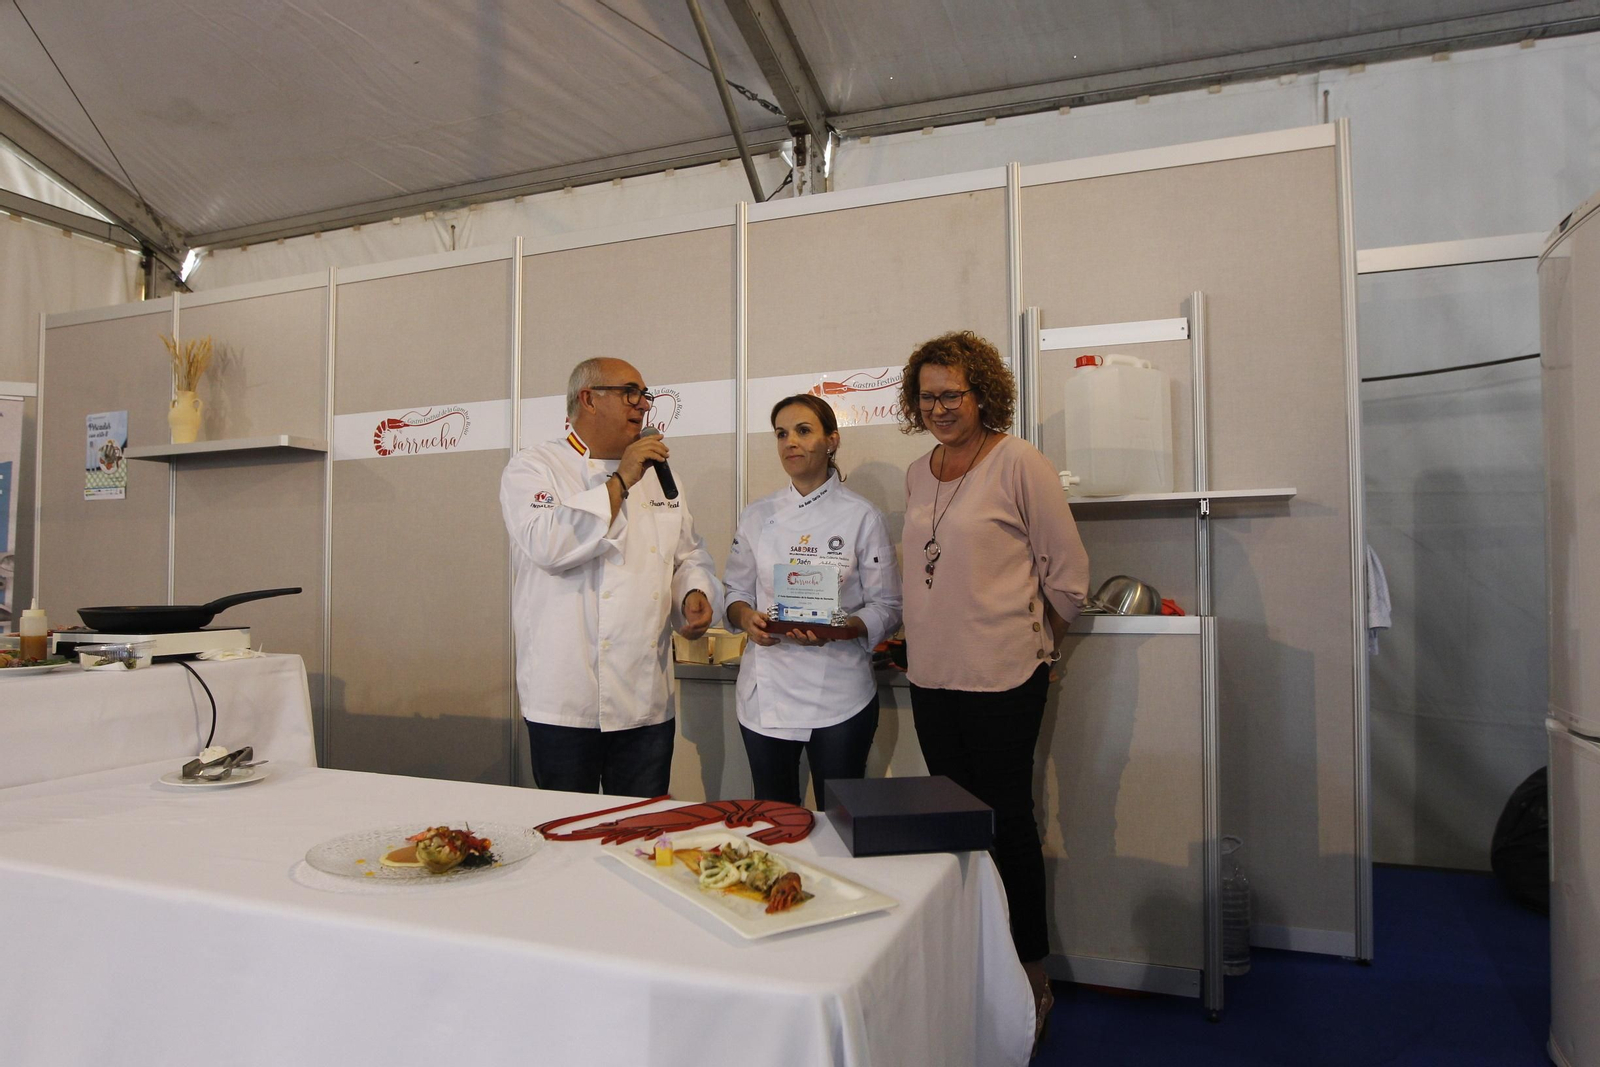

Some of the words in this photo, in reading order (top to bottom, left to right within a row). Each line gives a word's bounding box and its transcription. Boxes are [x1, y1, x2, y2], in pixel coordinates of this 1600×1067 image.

[852, 380, 875, 389] Gastro
[876, 373, 903, 387] Festival
[661, 387, 681, 403] Gamba
[674, 404, 683, 420] Roja
[452, 406, 469, 420] Gamba
[790, 545, 818, 553] SABORES
